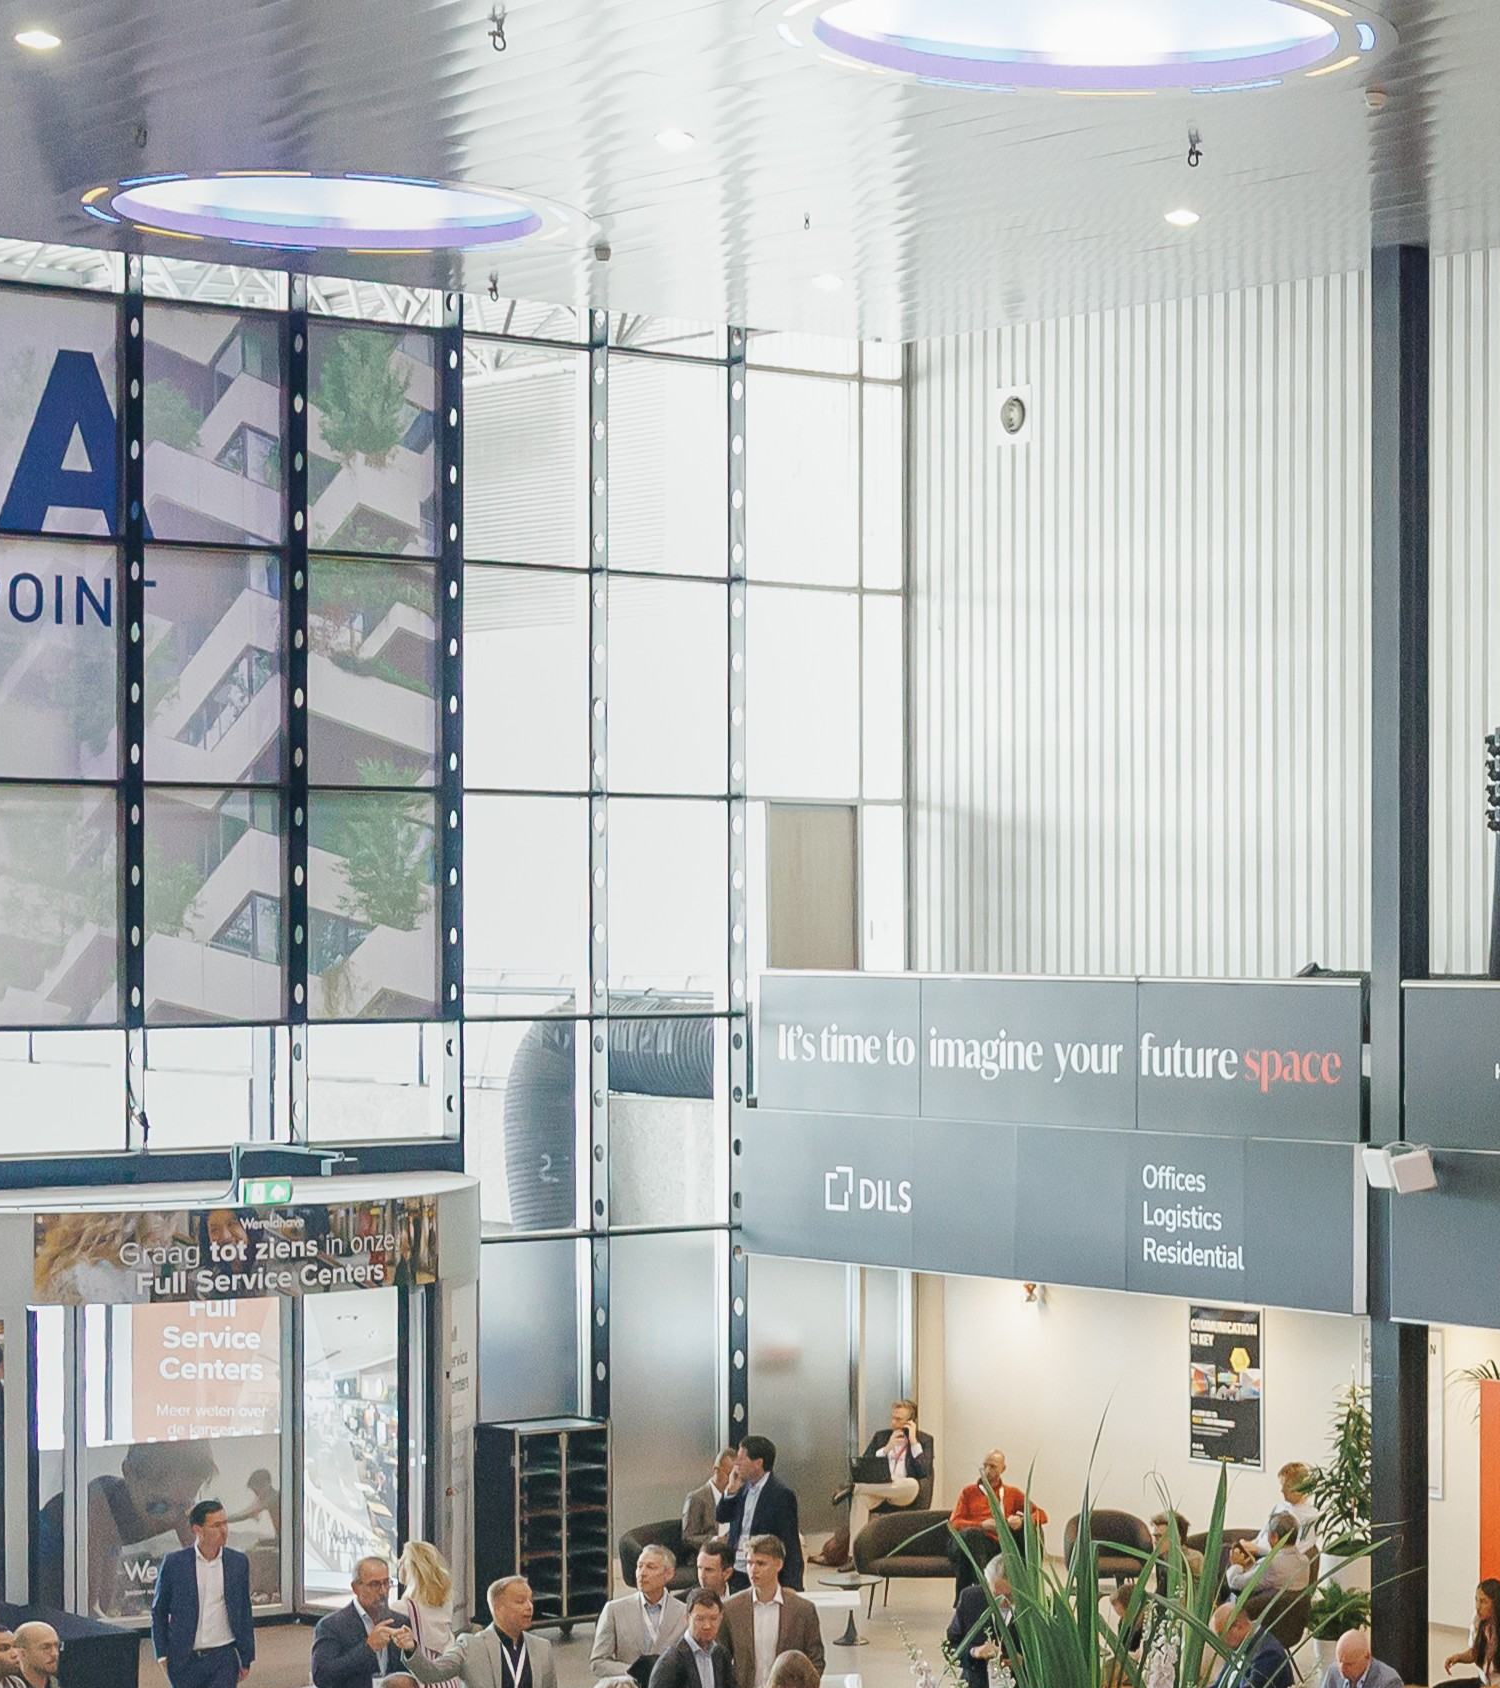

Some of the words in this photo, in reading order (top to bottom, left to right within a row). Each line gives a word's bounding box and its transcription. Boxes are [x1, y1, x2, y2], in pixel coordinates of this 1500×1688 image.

[778, 1023, 815, 1062] It's
[820, 1023, 881, 1065] time
[886, 1029, 915, 1066] to
[929, 1028, 1043, 1080] imagine
[1054, 1039, 1124, 1083] your
[1140, 1032, 1238, 1081] future
[1244, 1046, 1342, 1093] space
[1142, 1165, 1206, 1192] Offices
[859, 1178, 913, 1214] DILS
[1142, 1201, 1222, 1233] Logistics
[119, 1242, 200, 1268] Graag
[210, 1241, 248, 1263] tot
[256, 1237, 318, 1260] ziens
[326, 1235, 343, 1254] in
[351, 1233, 394, 1253] onze
[1142, 1238, 1245, 1270] Residential
[137, 1271, 186, 1295] Full
[197, 1269, 293, 1292] Service
[301, 1262, 385, 1286] Centers
[189, 1300, 237, 1317] Full
[163, 1326, 261, 1349] Service
[159, 1357, 264, 1380] Centers
